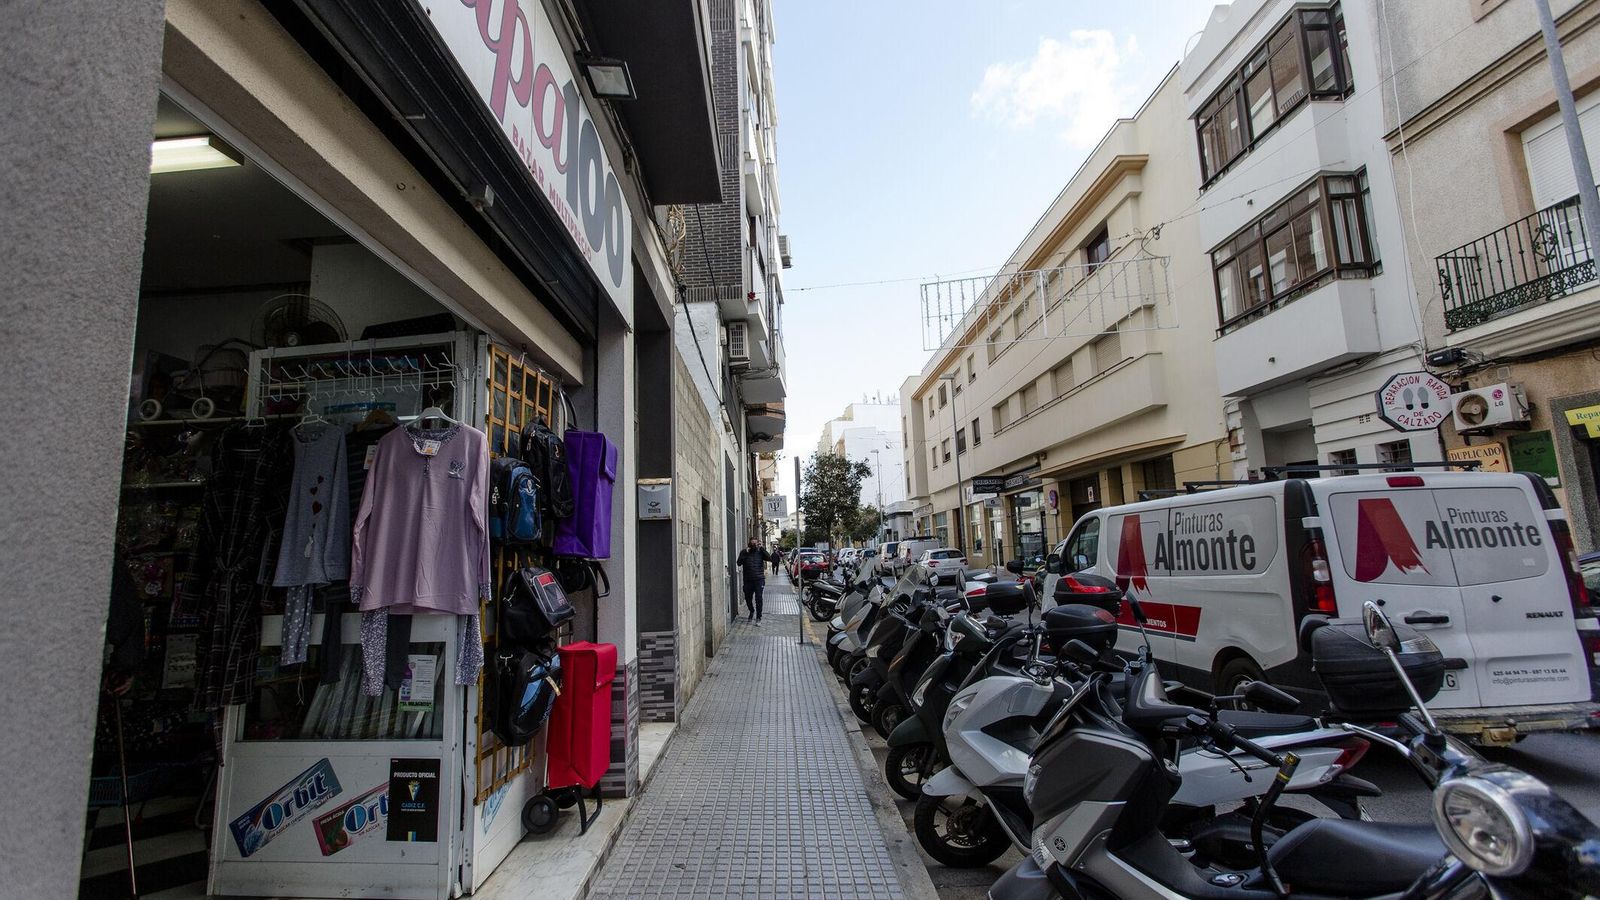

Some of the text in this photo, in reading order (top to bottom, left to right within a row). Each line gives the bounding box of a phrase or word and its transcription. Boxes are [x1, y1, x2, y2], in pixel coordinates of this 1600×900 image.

[512, 123, 545, 187] BAZAR
[1385, 376, 1448, 405] REPARACION RAPIDA
[1397, 411, 1442, 427] CALZADO
[1413, 410, 1424, 418] DE
[1450, 446, 1501, 461] DUPLICADO
[1174, 512, 1223, 535] Pinturas
[1447, 507, 1508, 524] Pinturas
[1426, 521, 1542, 549] Almonte
[1154, 529, 1256, 571] Almonte
[1525, 611, 1564, 619] RENAULT
[261, 771, 328, 831] Orbit
